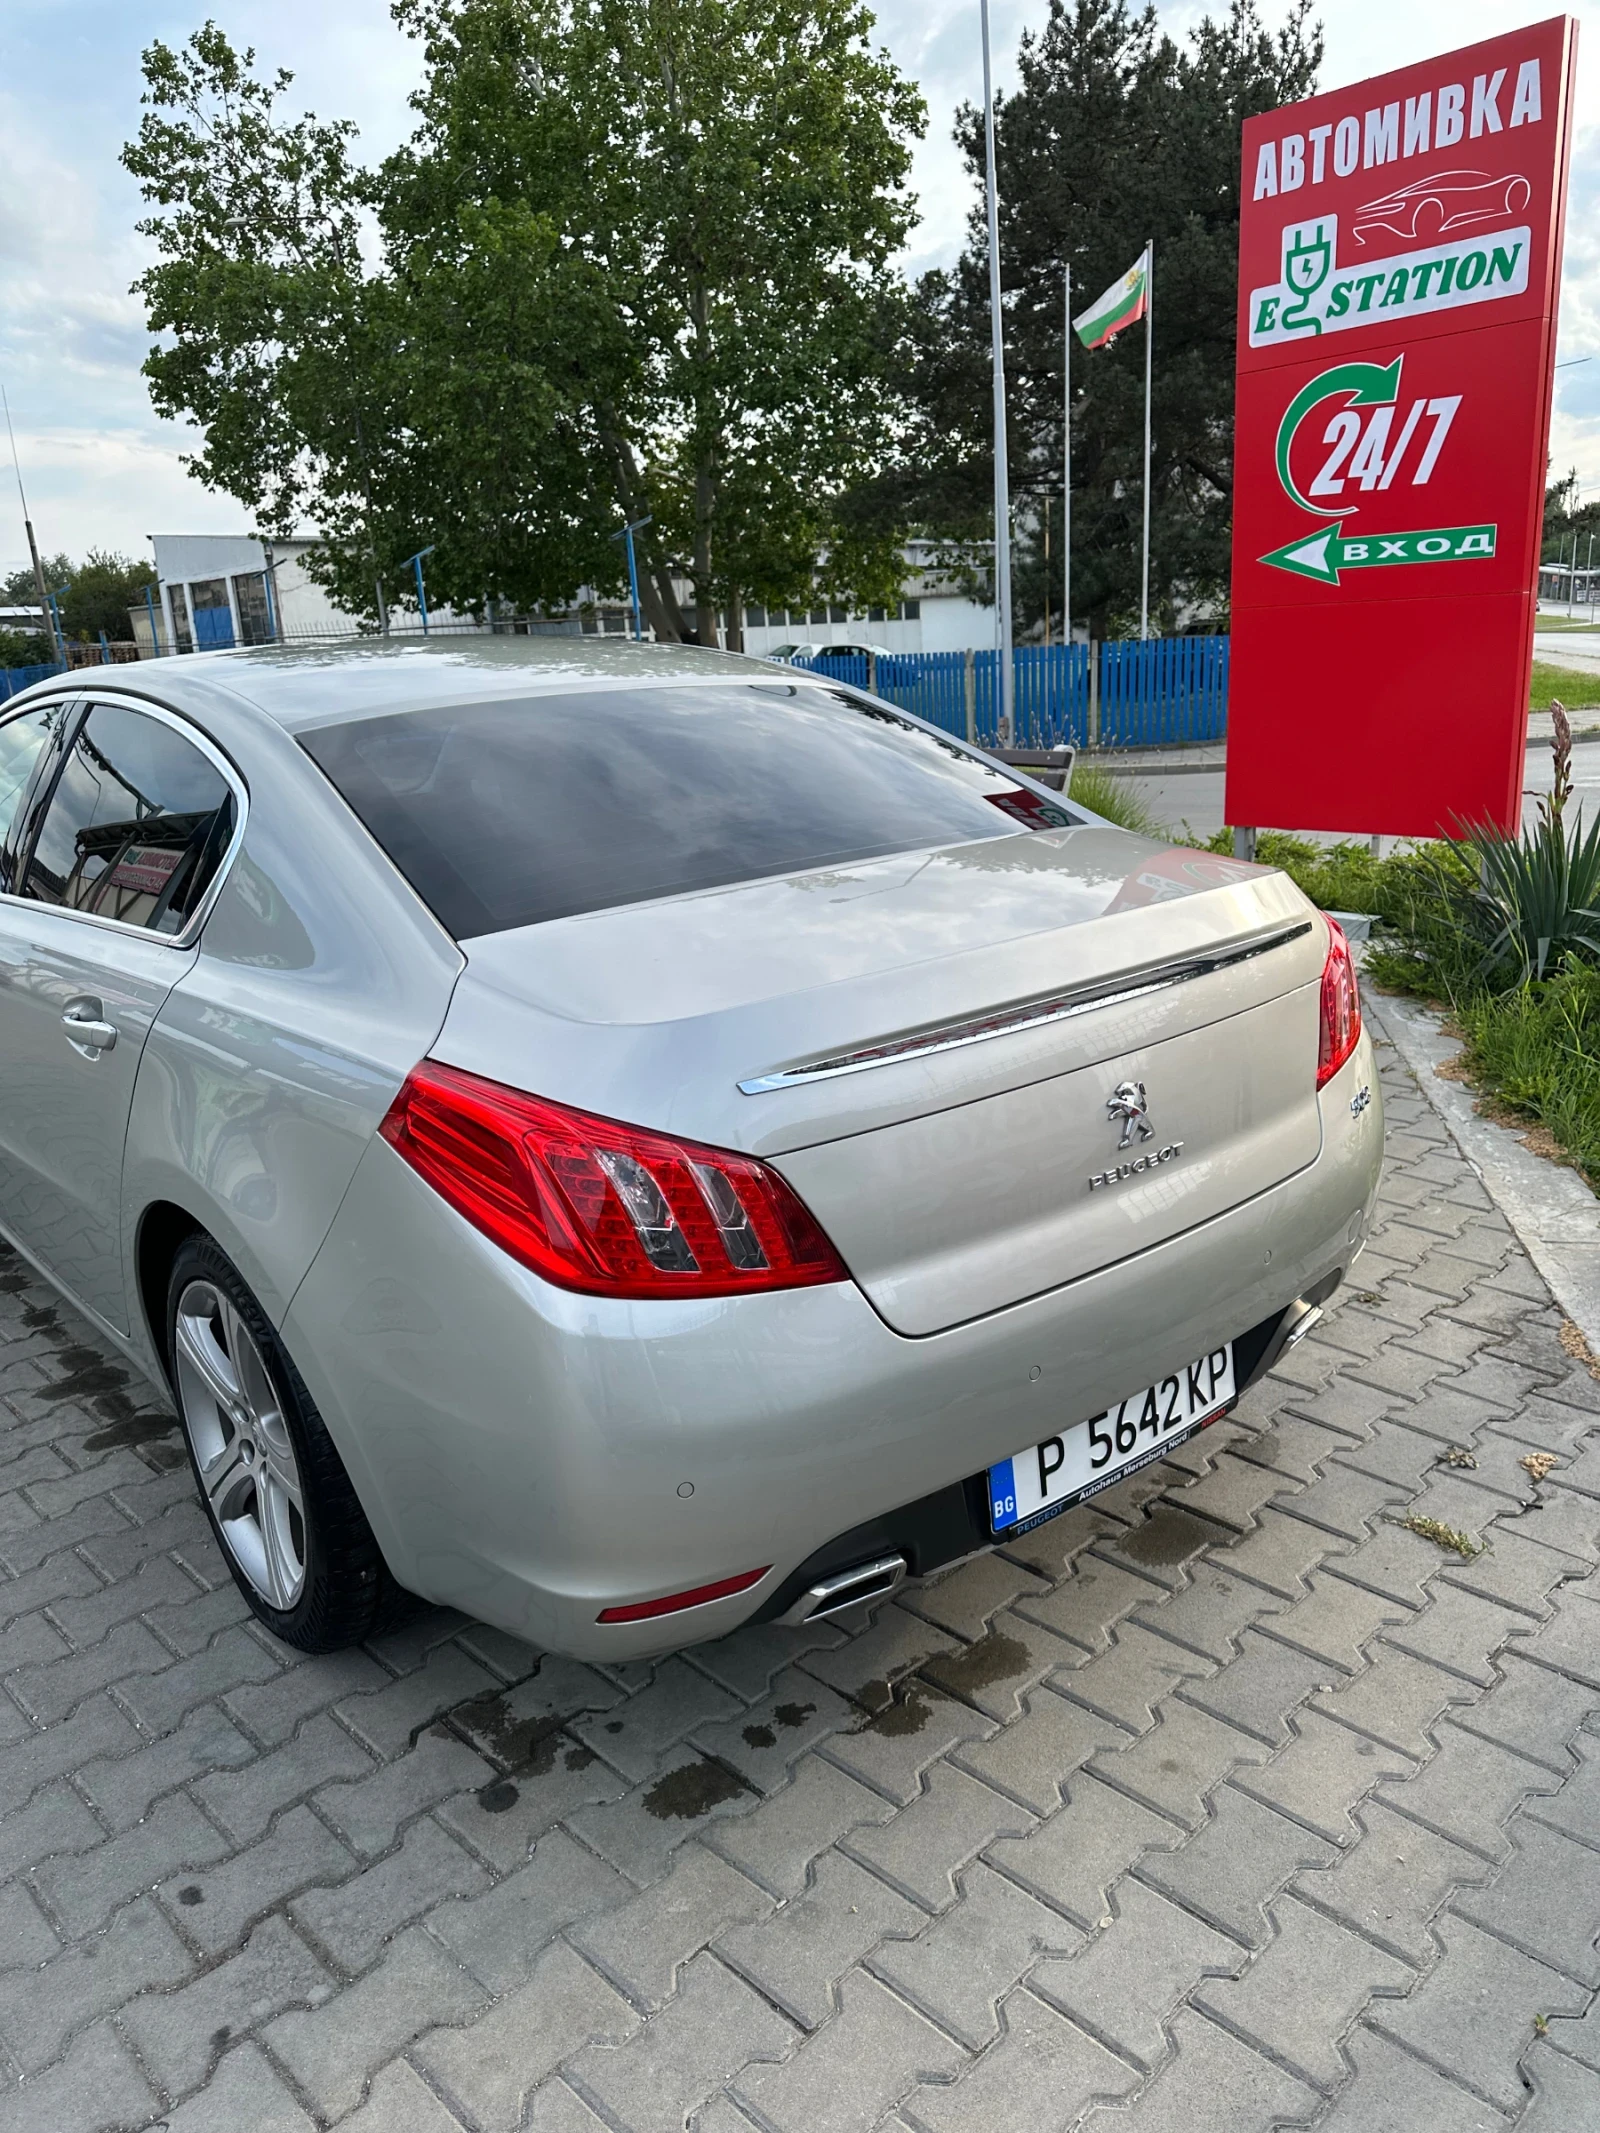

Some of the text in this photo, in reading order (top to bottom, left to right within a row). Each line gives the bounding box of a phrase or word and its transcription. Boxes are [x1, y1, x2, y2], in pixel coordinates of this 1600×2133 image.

[1253, 58, 1542, 201] АВТОМИВКА
[1254, 243, 1523, 334] E STATION
[1308, 395, 1463, 496] 24/7
[1343, 533, 1494, 562] ВХОД
[1089, 1142, 1185, 1191] PEUGEOT
[1201, 1407, 1226, 1429] NISSAN
[1037, 1436, 1065, 1498] P
[1078, 1431, 1188, 1502] Autohaus Merseburg Nord
[994, 1495, 1014, 1519] BG
[1017, 1504, 1065, 1535] PEUGEOT
